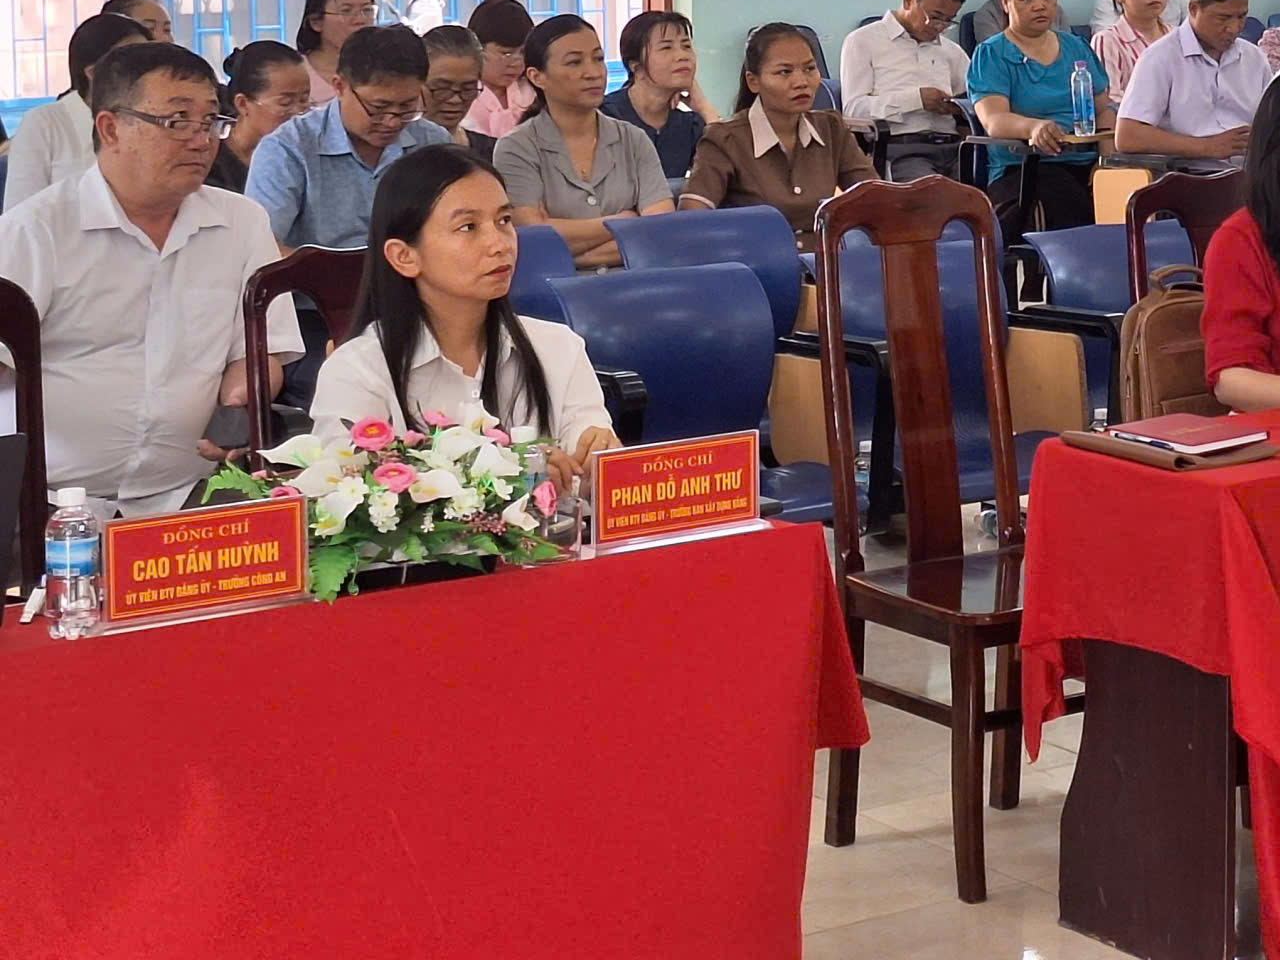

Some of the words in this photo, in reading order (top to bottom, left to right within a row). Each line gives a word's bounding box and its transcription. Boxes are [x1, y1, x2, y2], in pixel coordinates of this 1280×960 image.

[642, 456, 684, 474] ĐỒNG
[688, 452, 713, 466] CHÍ
[611, 485, 653, 508] PHAN
[656, 473, 676, 501] ĐỖ
[680, 475, 710, 497] ANH
[714, 468, 743, 490] THƯ
[163, 525, 213, 544] ĐỒNG
[218, 518, 249, 535] CHÍ
[133, 557, 170, 582] CAO
[175, 545, 212, 575] TẤN
[218, 541, 279, 569] HUỲNH
[125, 591, 137, 605] ỦY
[139, 587, 158, 603] VIÊN
[159, 587, 174, 601] BTV
[176, 582, 199, 598] ĐẢNG
[200, 579, 211, 594] ỦY
[218, 573, 249, 591] TRƯỞNG
[251, 571, 273, 586] CÔNG
[274, 571, 286, 583] AN
